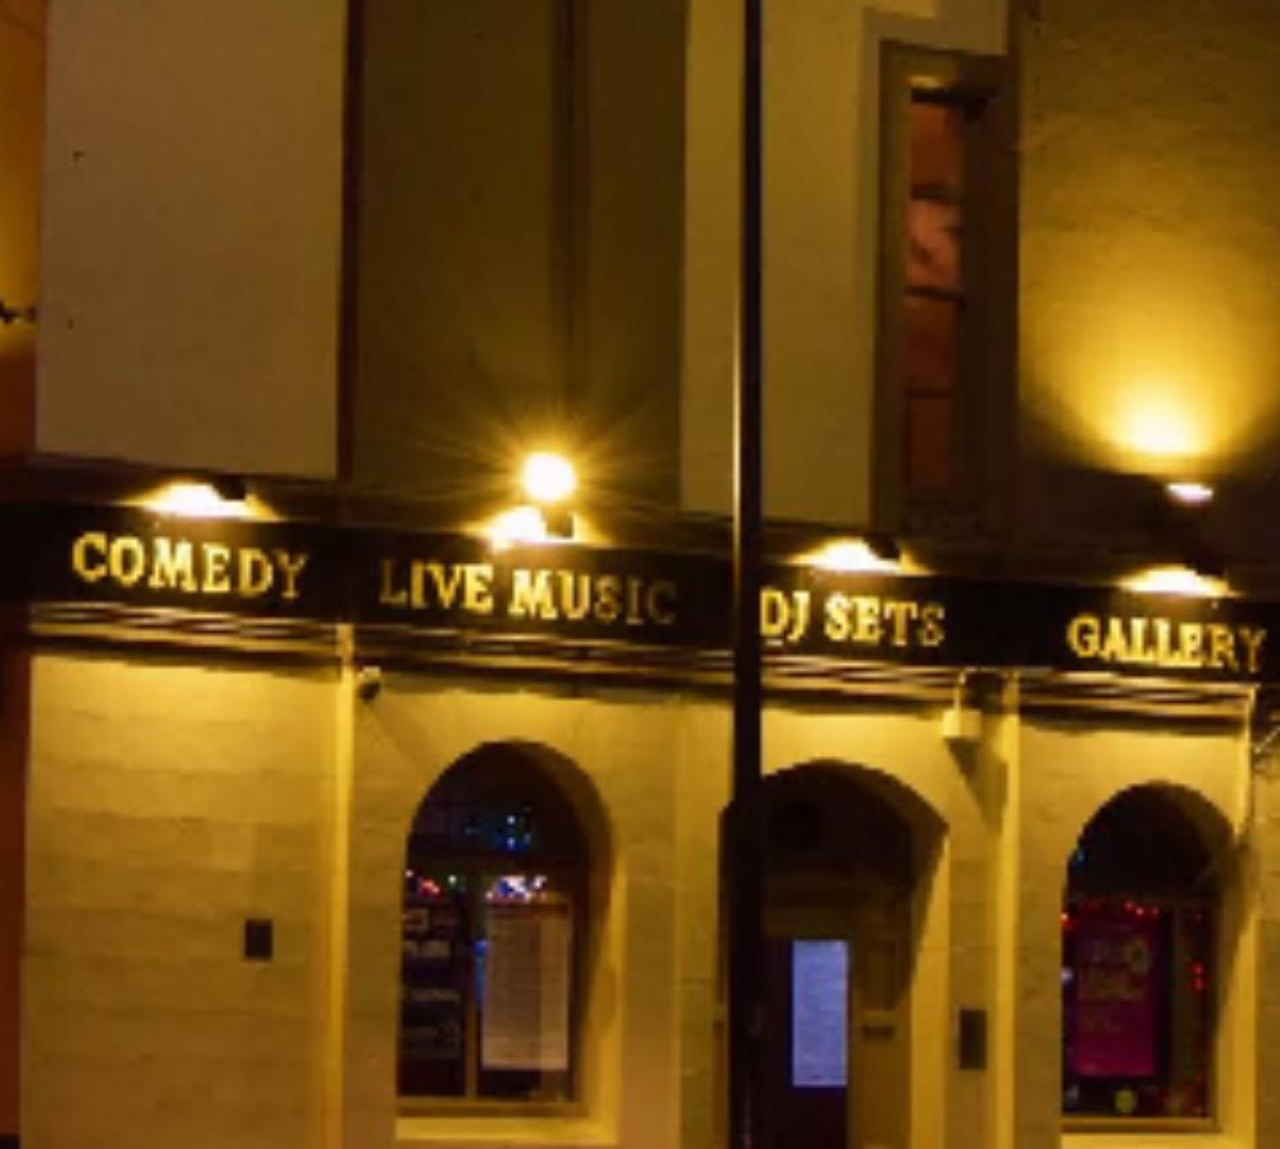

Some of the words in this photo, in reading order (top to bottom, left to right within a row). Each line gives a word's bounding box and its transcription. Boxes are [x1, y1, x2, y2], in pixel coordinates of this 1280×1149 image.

[71, 531, 309, 599] COMEDY
[378, 557, 495, 614] LIVE
[507, 566, 680, 627] MUSIC
[759, 588, 811, 641] DJ
[823, 592, 947, 648] SETS
[1066, 615, 1269, 672] GALLERY
